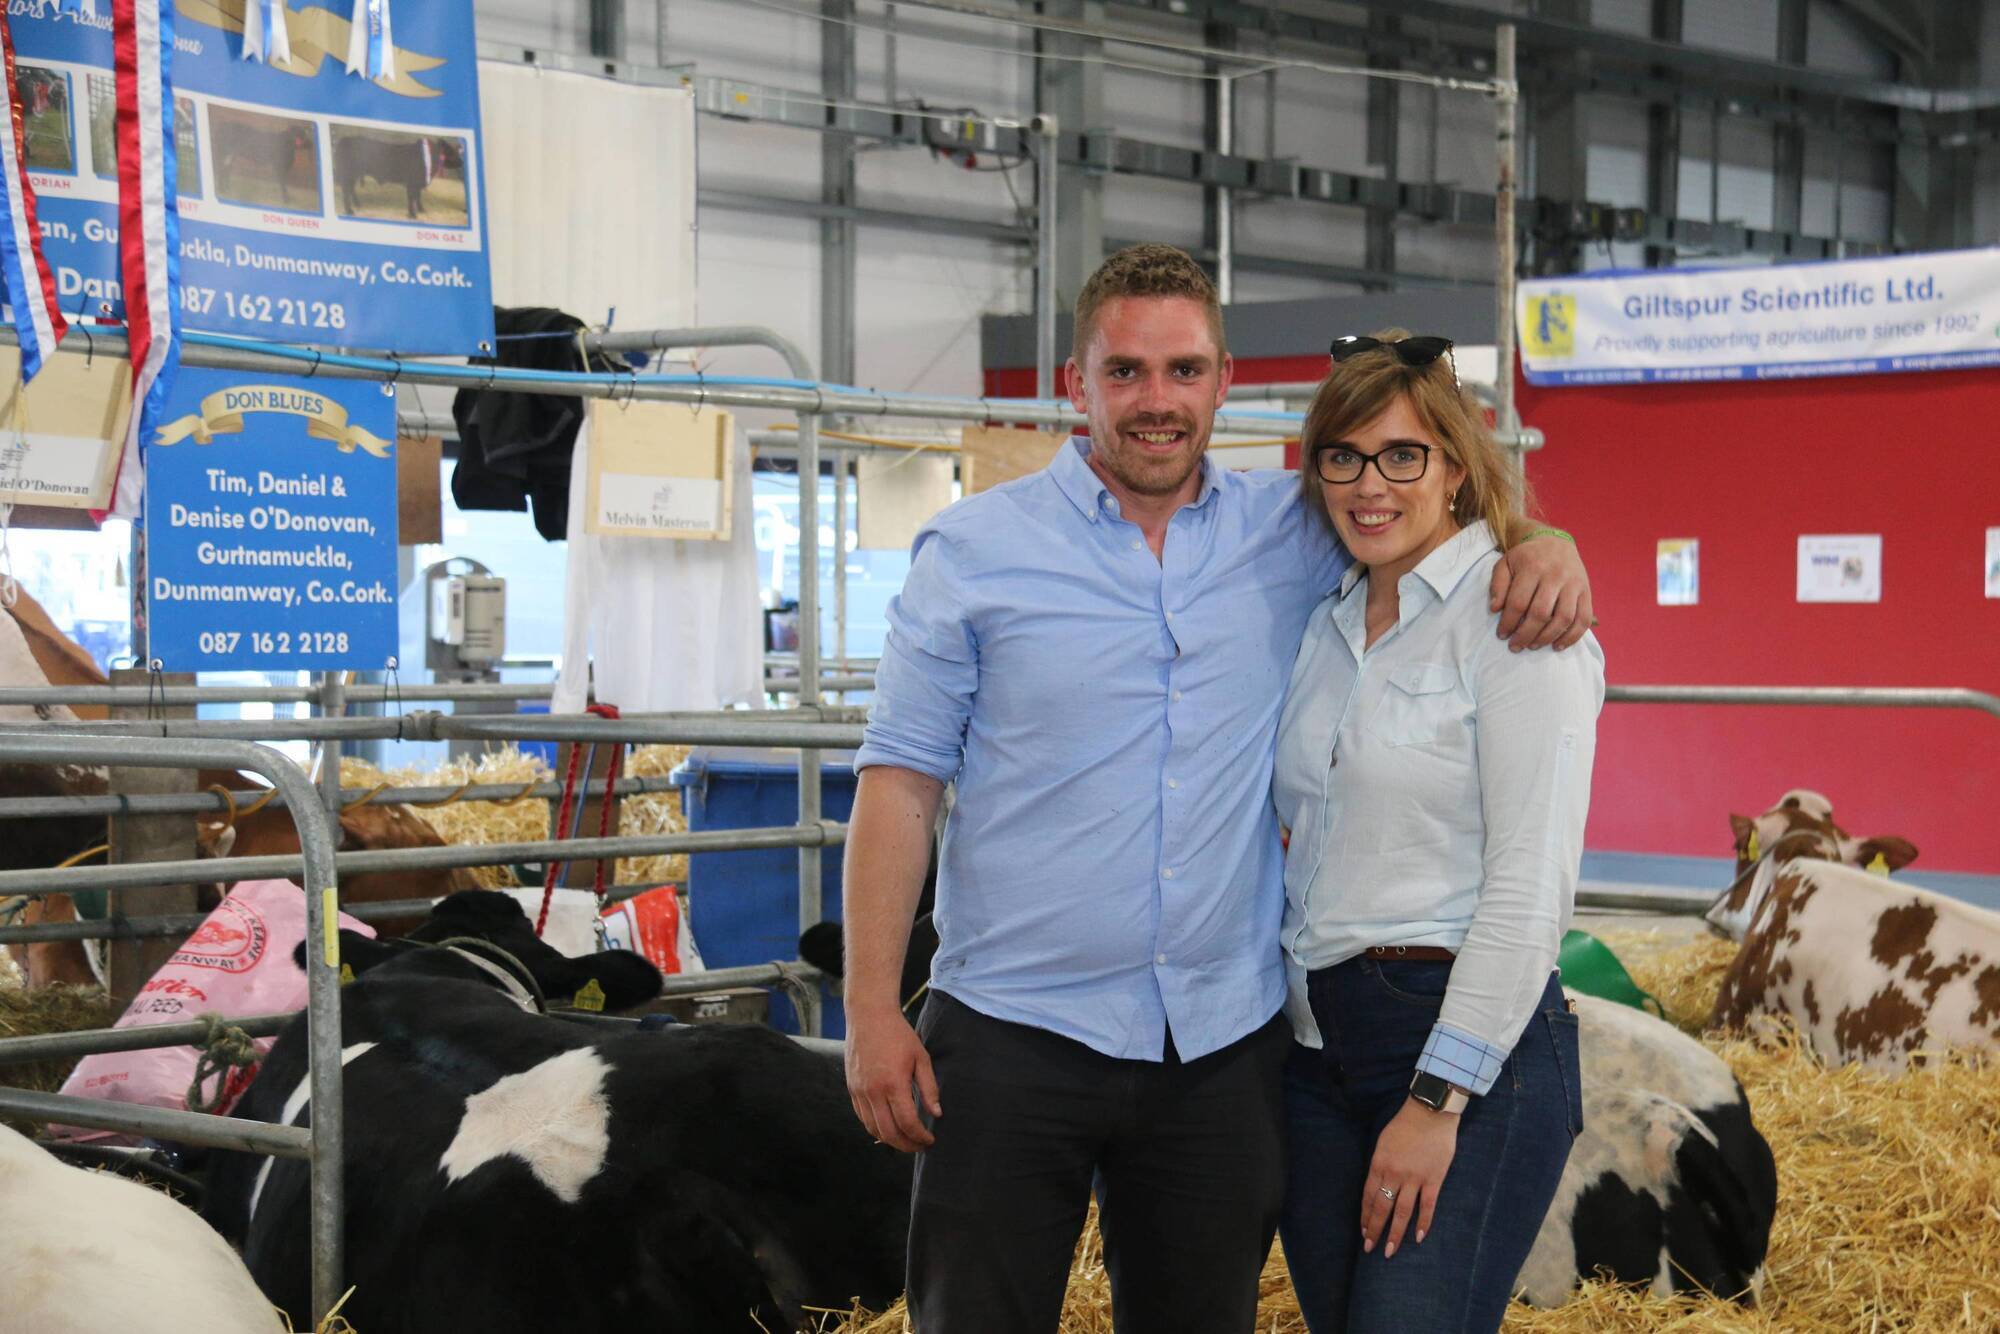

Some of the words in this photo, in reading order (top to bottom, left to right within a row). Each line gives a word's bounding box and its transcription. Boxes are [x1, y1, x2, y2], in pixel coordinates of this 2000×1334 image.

[31, 176, 71, 189] ORIAH
[416, 230, 439, 242] DON
[443, 233, 464, 243] GAZ
[235, 244, 376, 286] Dunmanway,
[380, 261, 473, 288] Co.Cork.
[224, 291, 273, 322] 162
[277, 298, 346, 329] 2128
[1623, 293, 1732, 321] Giltspur
[1739, 280, 1875, 314] Scientific
[1885, 275, 1944, 304] Ltd.
[1594, 333, 1662, 354] Proudly
[1667, 329, 1760, 350] supporting
[1766, 325, 1866, 348] agriculture
[1872, 320, 1925, 339] since
[224, 391, 264, 411] DON
[268, 390, 324, 414] BLUES
[18, 479, 89, 494] O'Donovan
[206, 468, 254, 498] Tim,
[258, 470, 326, 497] Daniel
[331, 474, 347, 497] &
[170, 504, 245, 530] Denise
[249, 506, 376, 537] O'Donovan,
[605, 511, 647, 527] Melvin
[197, 541, 353, 572] Gurtnamuckla,
[154, 578, 302, 608] Dunmanway,
[306, 580, 393, 605] Co.Cork.
[199, 632, 241, 654] 087
[299, 632, 349, 654] 2128
